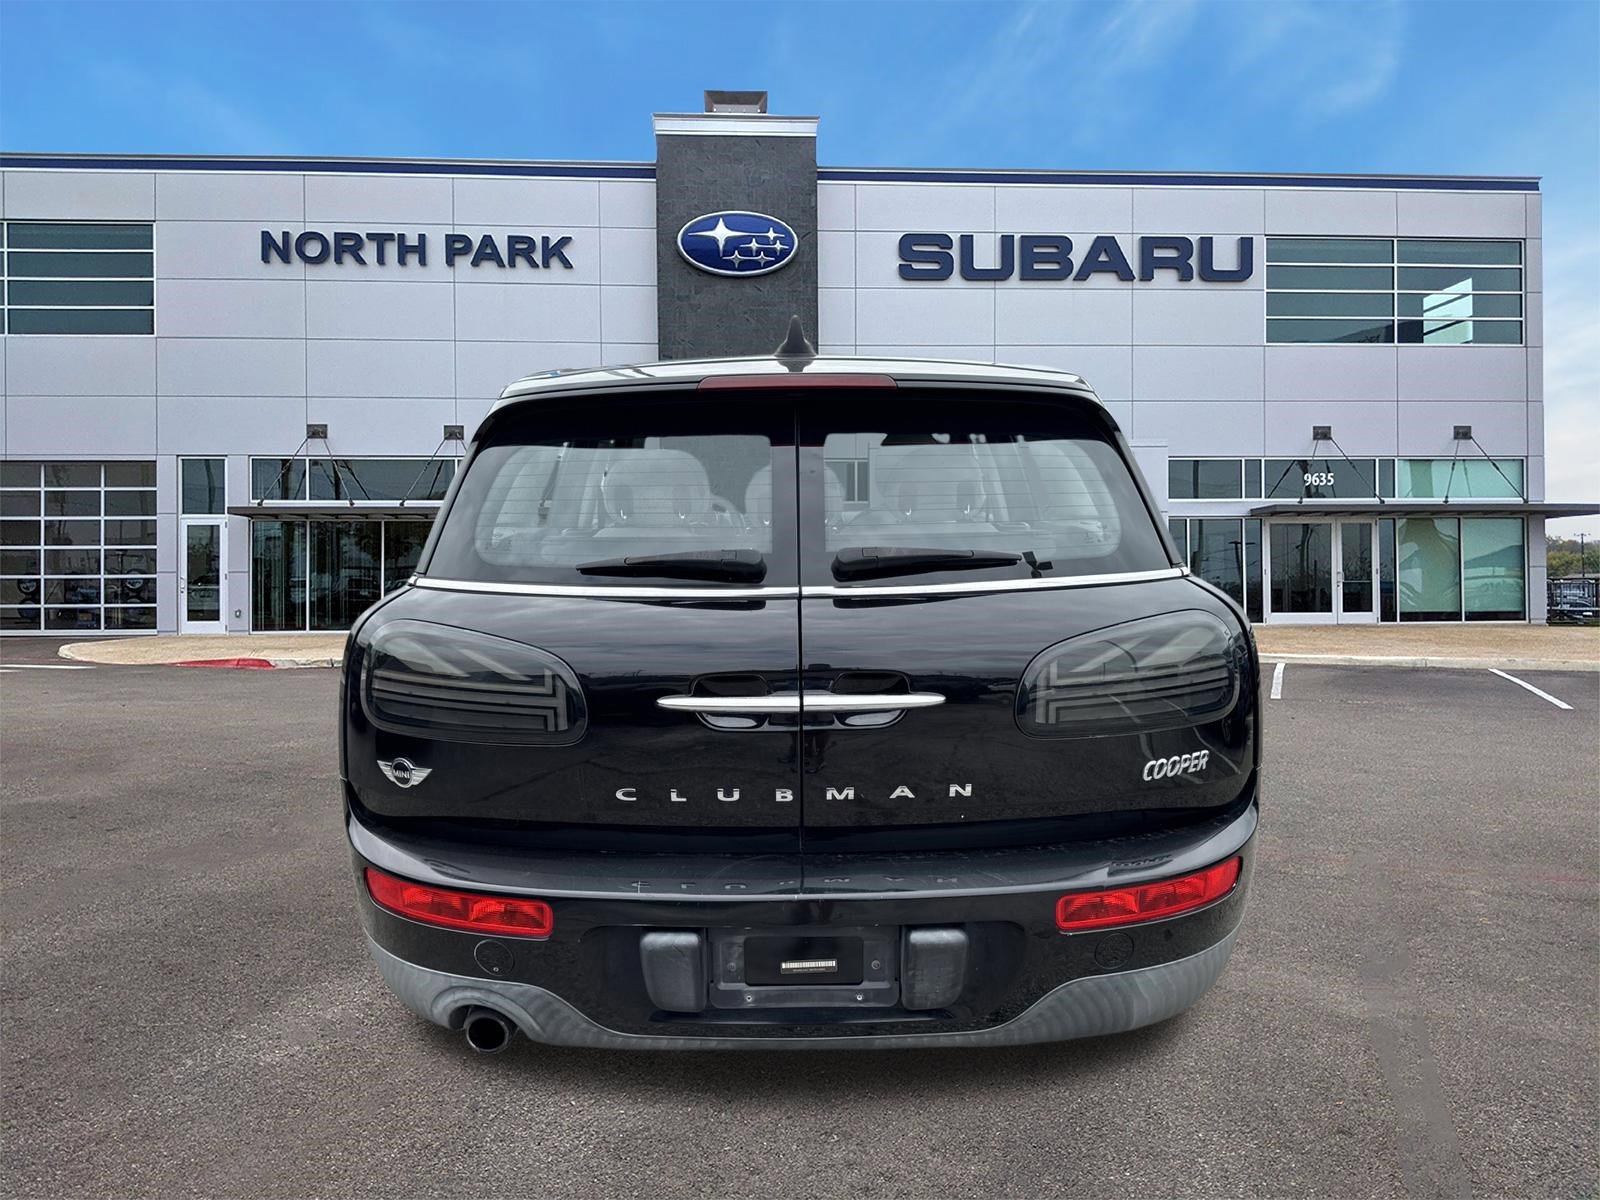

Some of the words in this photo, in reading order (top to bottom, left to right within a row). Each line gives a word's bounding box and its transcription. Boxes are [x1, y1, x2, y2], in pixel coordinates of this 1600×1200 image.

[261, 230, 427, 267] NORTH
[445, 234, 573, 269] PARK
[898, 233, 1254, 282] SUBARU
[1303, 472, 1335, 487] 9635
[392, 768, 411, 779] MINI
[1143, 749, 1209, 782] COOPER
[615, 783, 973, 802] CLUBMAN
